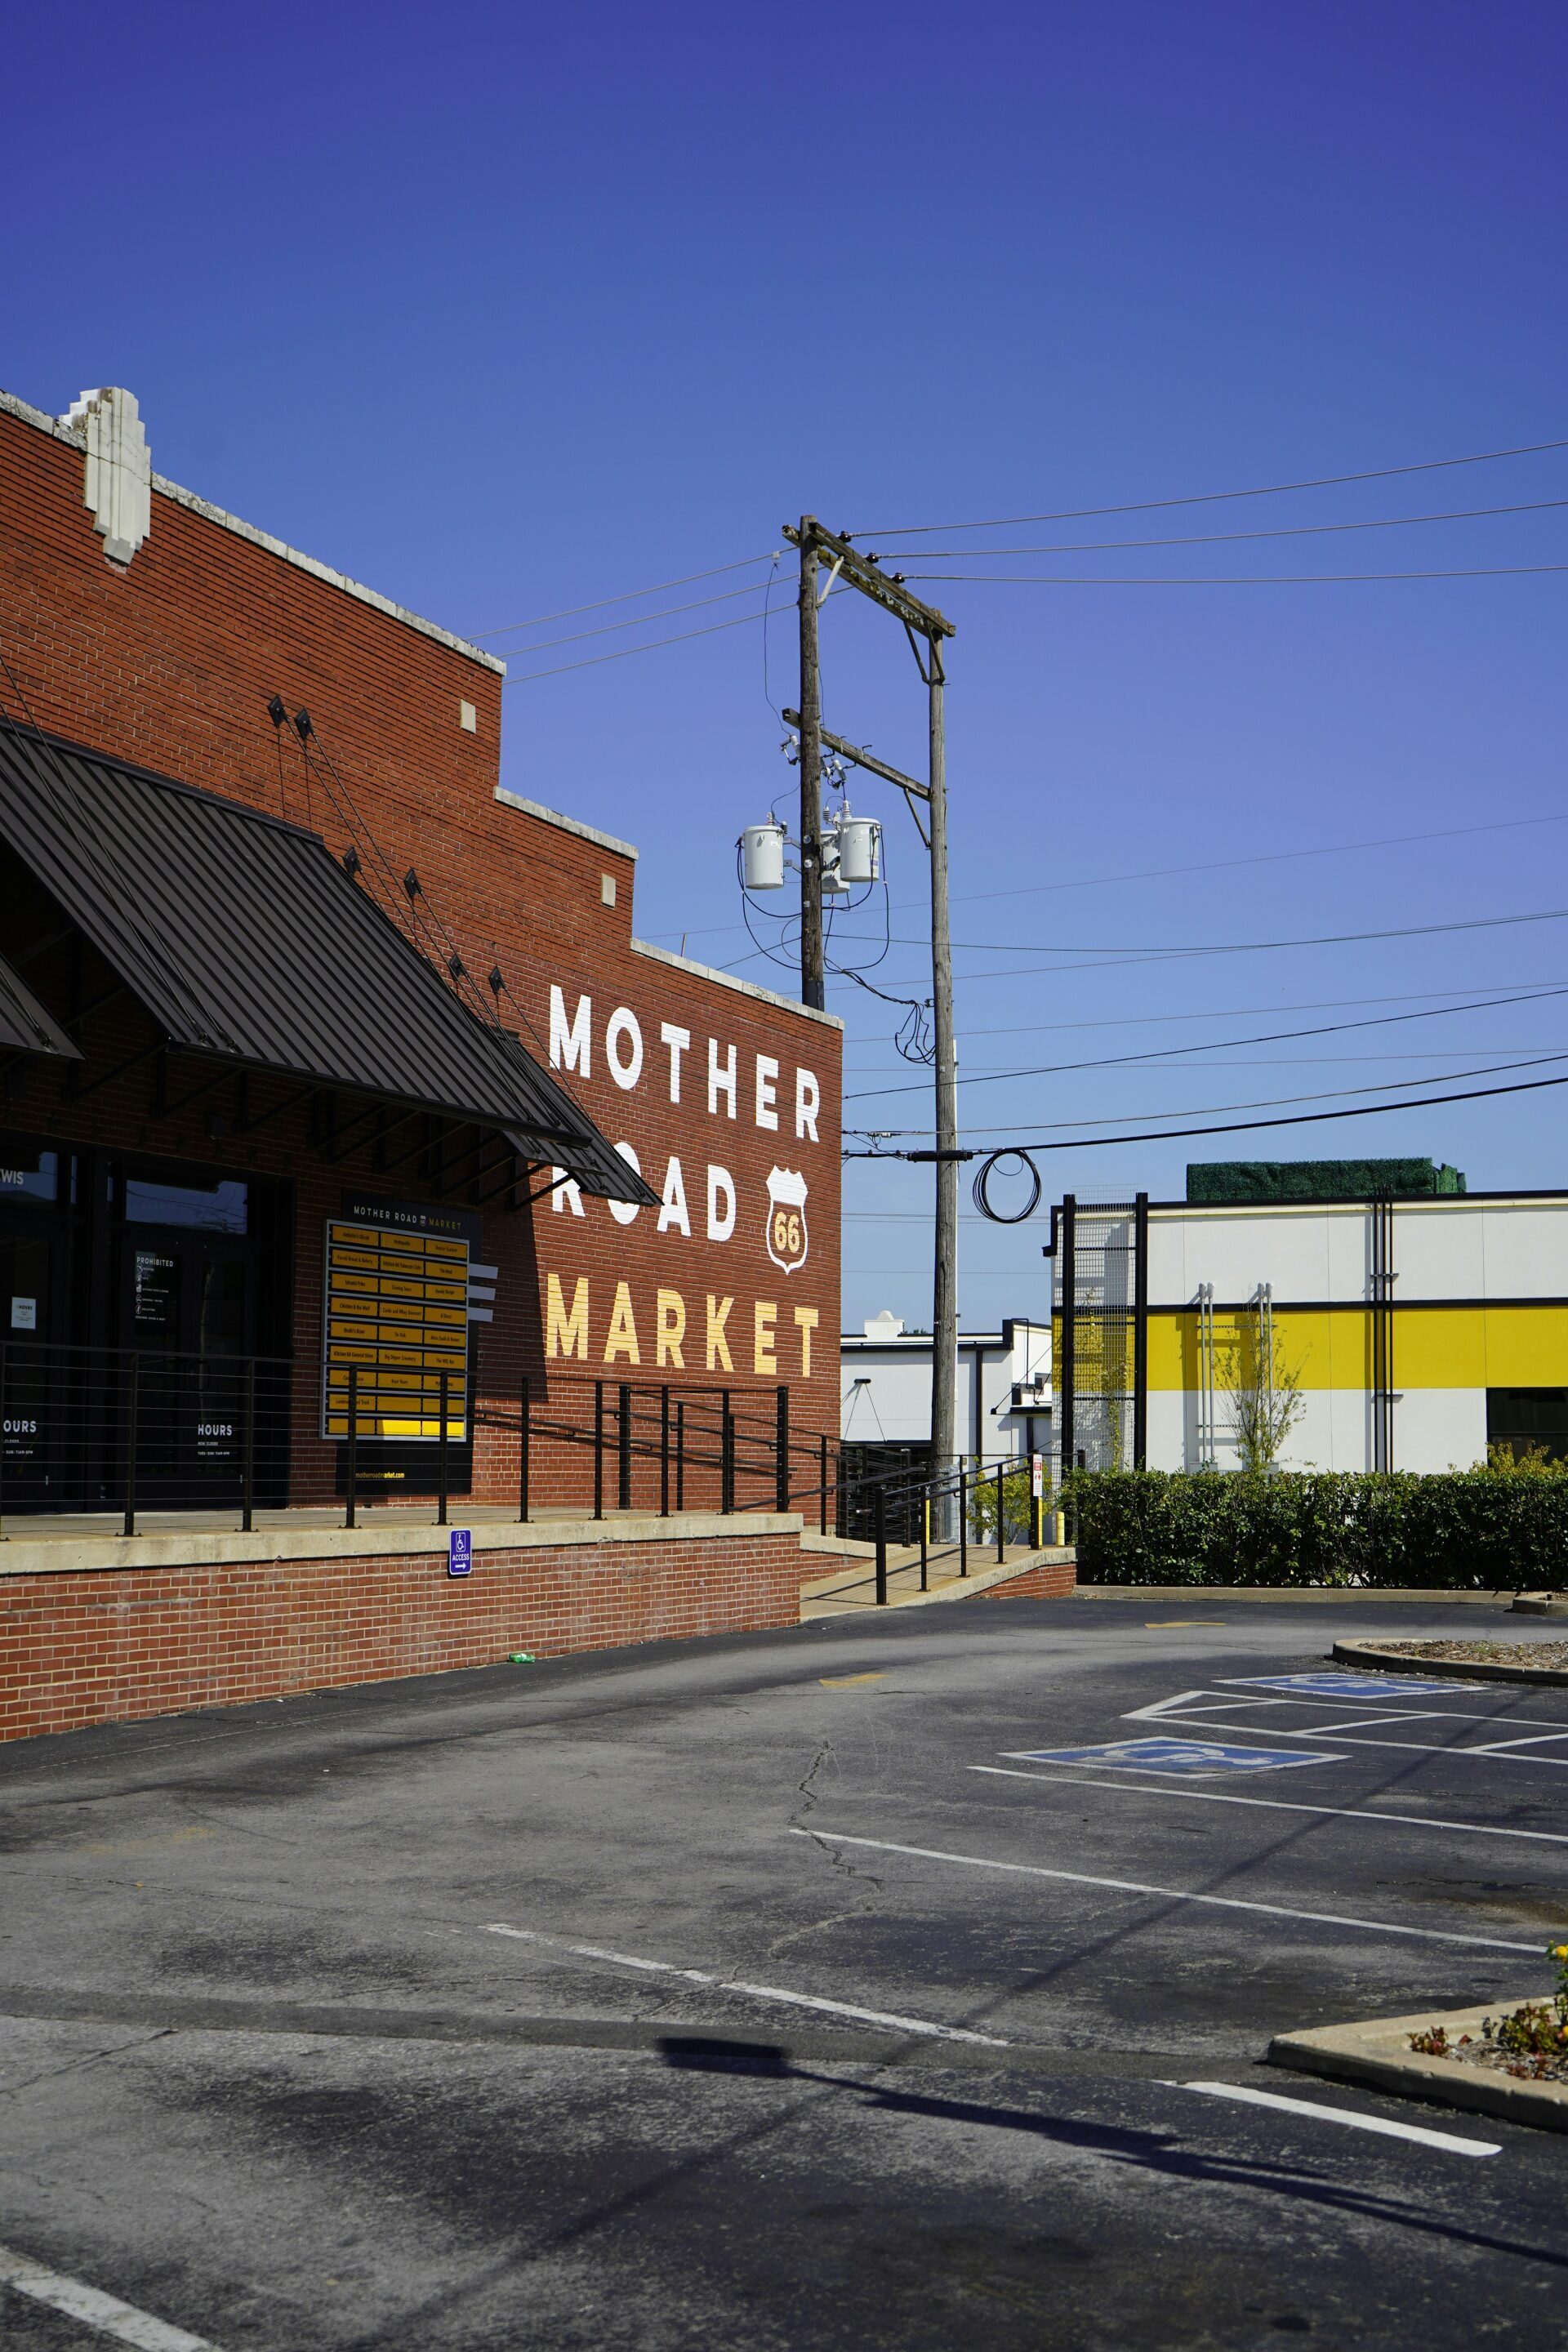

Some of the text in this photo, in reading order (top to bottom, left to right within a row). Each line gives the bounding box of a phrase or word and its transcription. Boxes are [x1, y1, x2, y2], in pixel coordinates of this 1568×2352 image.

[550, 985, 820, 1143] MOTHER
[0, 1168, 24, 1185] WIS
[354, 1205, 390, 1219] MOTHER
[394, 1212, 416, 1223] ROAD
[429, 1217, 461, 1230] MARKET
[774, 1212, 800, 1253] 66
[136, 1257, 173, 1267] PROHIBITED
[546, 1273, 819, 1377] MARKET
[3, 1419, 37, 1432] OURS
[198, 1423, 232, 1436] HOURS
[452, 1553, 470, 1561] ACCESS
